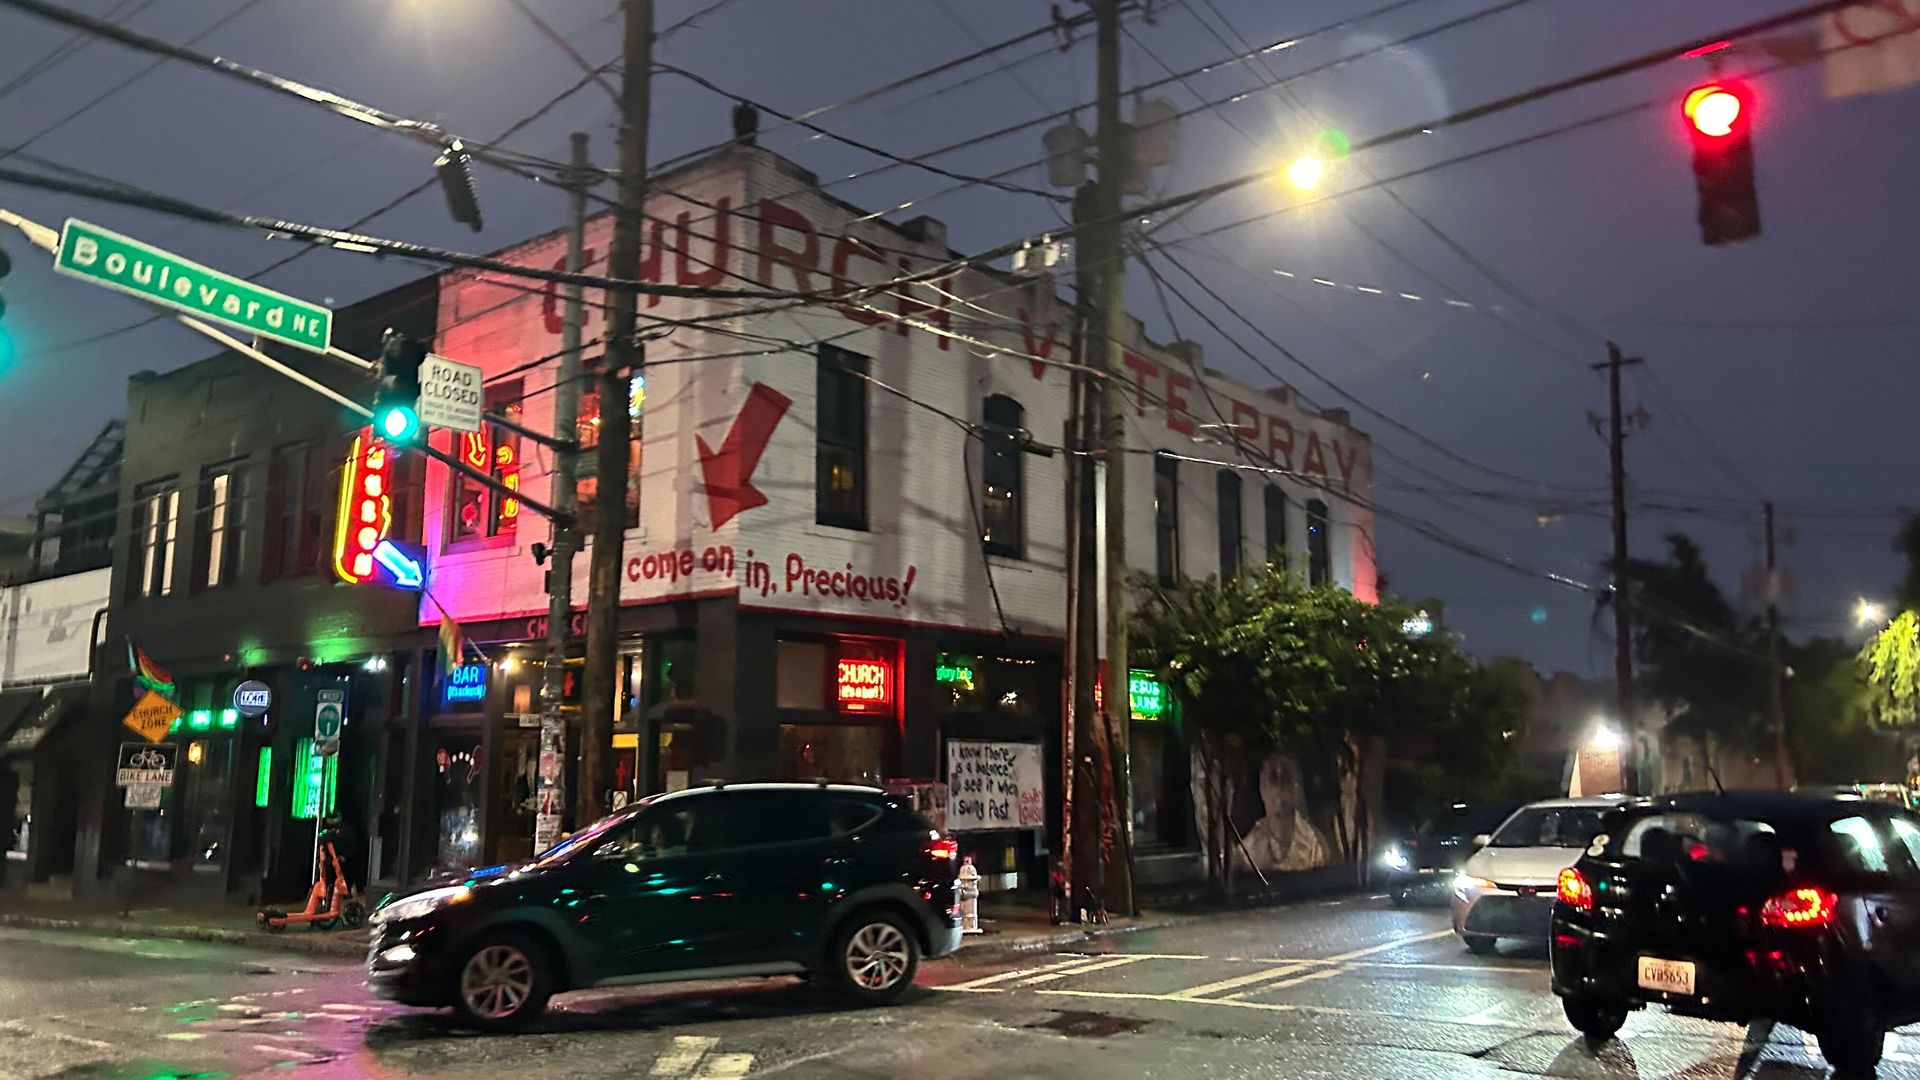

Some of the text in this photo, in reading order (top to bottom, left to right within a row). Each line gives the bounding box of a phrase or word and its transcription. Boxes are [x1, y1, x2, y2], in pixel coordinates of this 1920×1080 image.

[72, 236, 321, 338] Boulevard NE
[432, 365, 472, 386] ROAD
[424, 381, 479, 405] CLOSED
[1018, 308, 1197, 438] VTE
[1231, 400, 1358, 494] PRAY
[627, 545, 916, 606] come on in, Precious!
[453, 666, 479, 684] BAR
[838, 663, 884, 685] CHURCH
[133, 705, 173, 719] CHURCH
[141, 719, 167, 730] ZONE
[119, 769, 172, 783] BIKE LANE
[964, 778, 983, 793] see
[986, 777, 994, 793] it
[997, 779, 1019, 798] when
